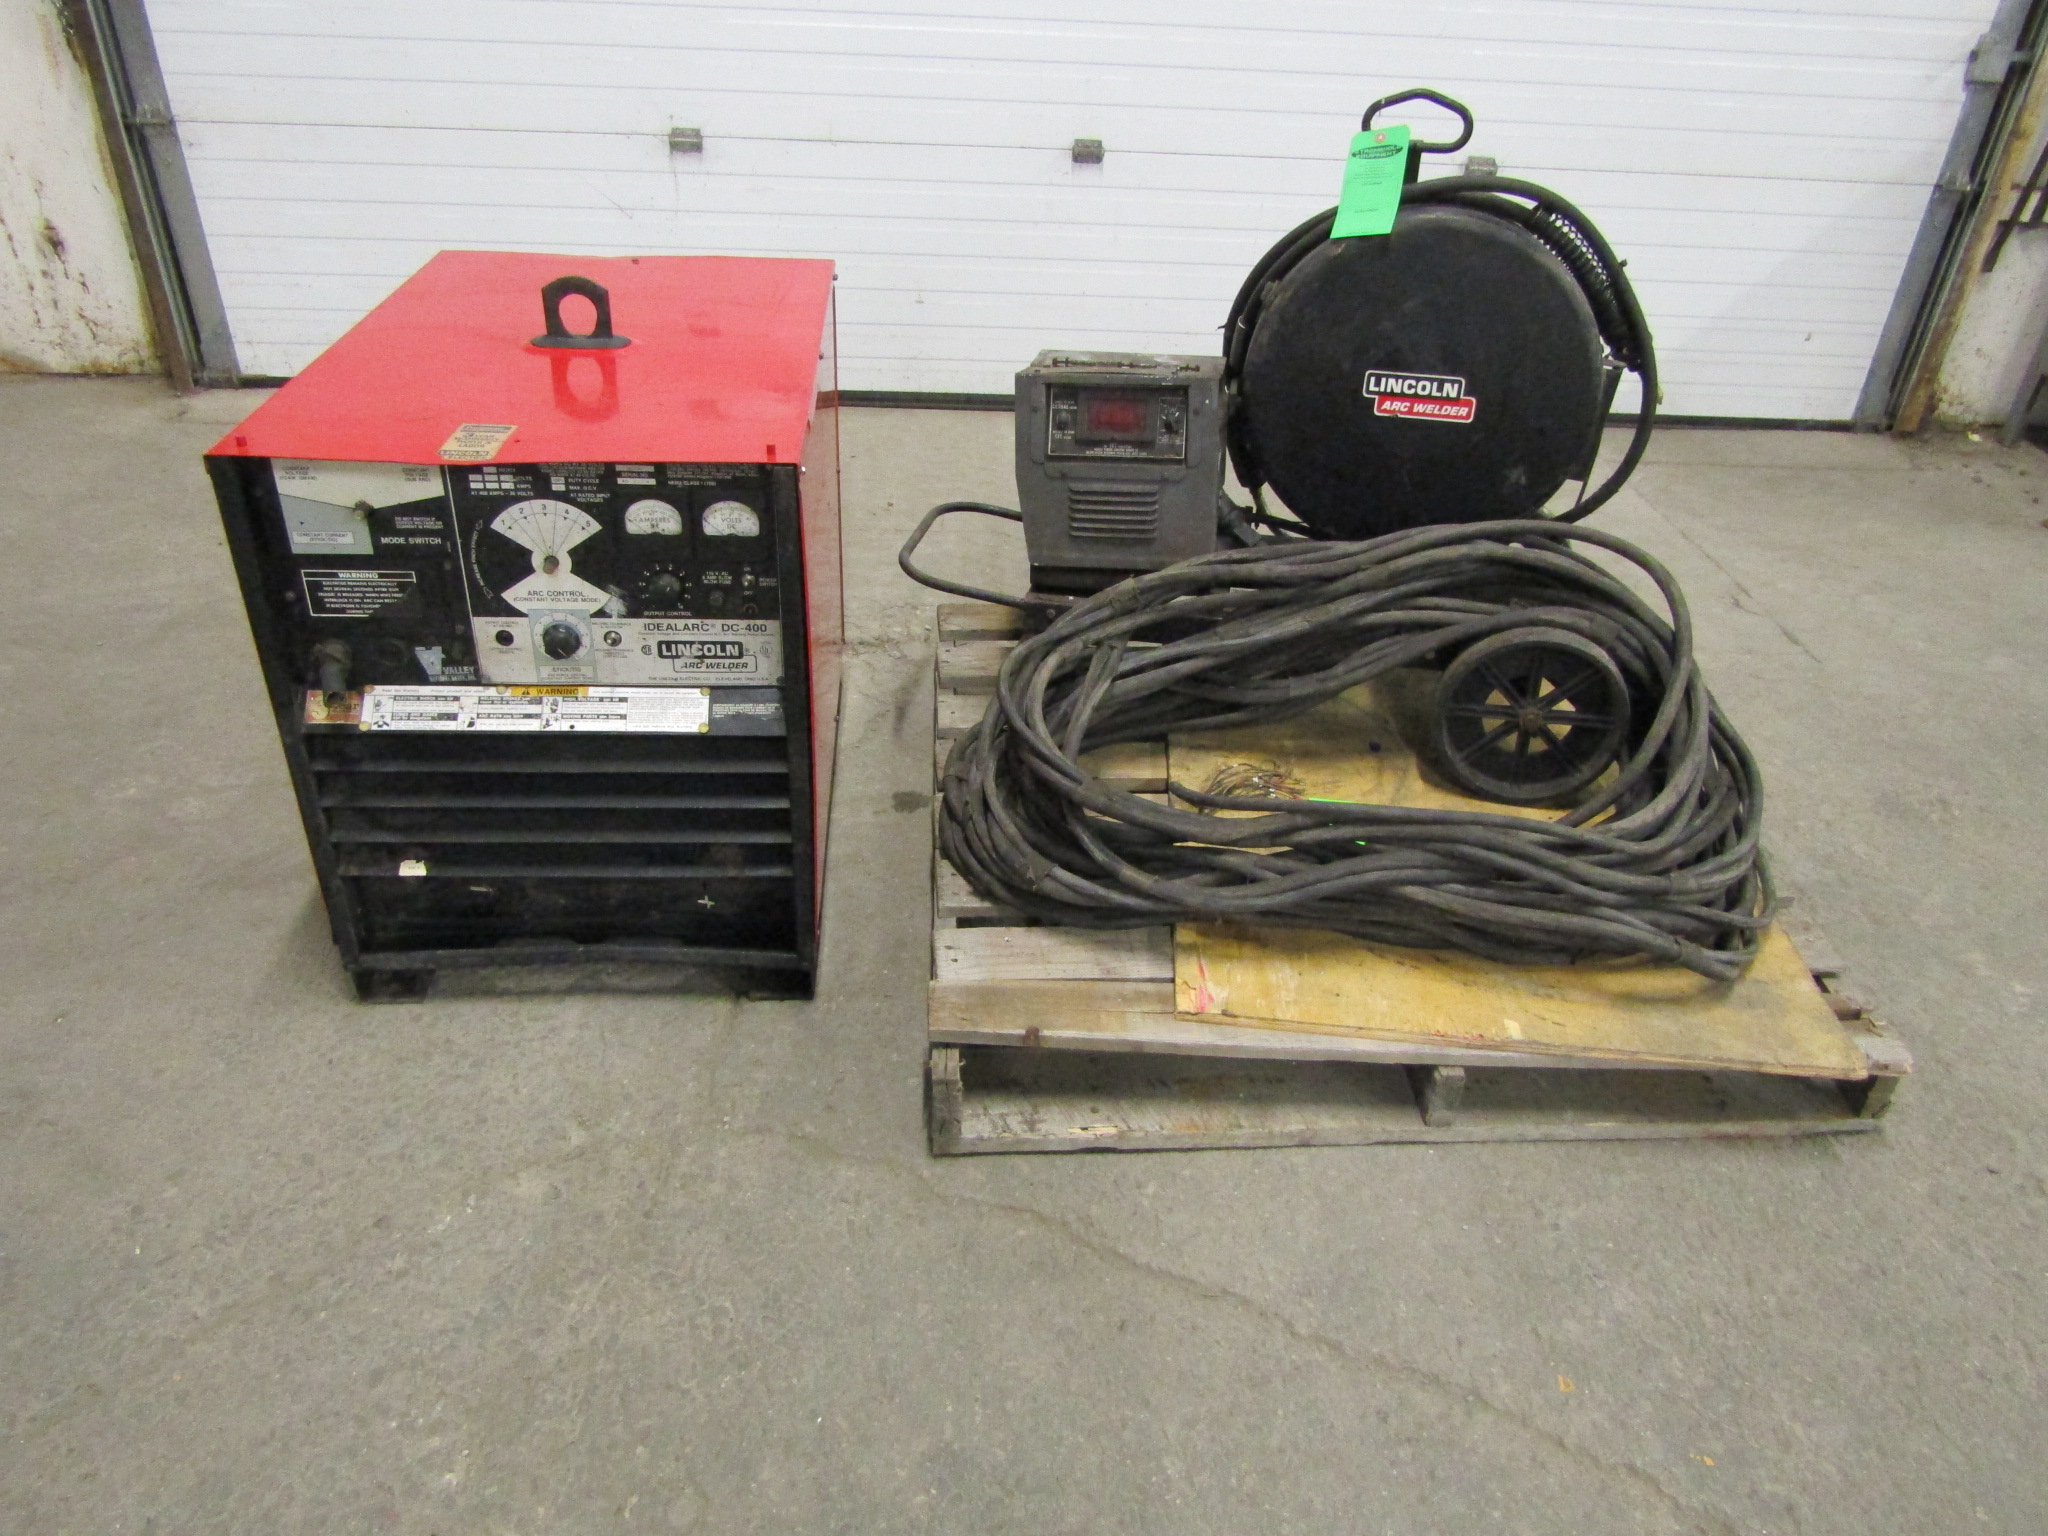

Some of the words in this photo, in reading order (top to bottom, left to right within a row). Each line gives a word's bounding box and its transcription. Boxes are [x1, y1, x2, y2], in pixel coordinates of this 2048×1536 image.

[1368, 376, 1459, 398] LINCOLN
[1381, 400, 1410, 412] ARC
[1413, 402, 1469, 417] WELDER
[586, 520, 592, 528] 5
[380, 536, 407, 545] MODE
[408, 537, 442, 545] SWITCH
[546, 590, 586, 598] CONTROL
[721, 623, 767, 632] DC-400
[662, 643, 739, 657] LINCOLN
[681, 661, 703, 669] ARC
[442, 666, 475, 674] VALLEY
[536, 687, 579, 696] WARNING
